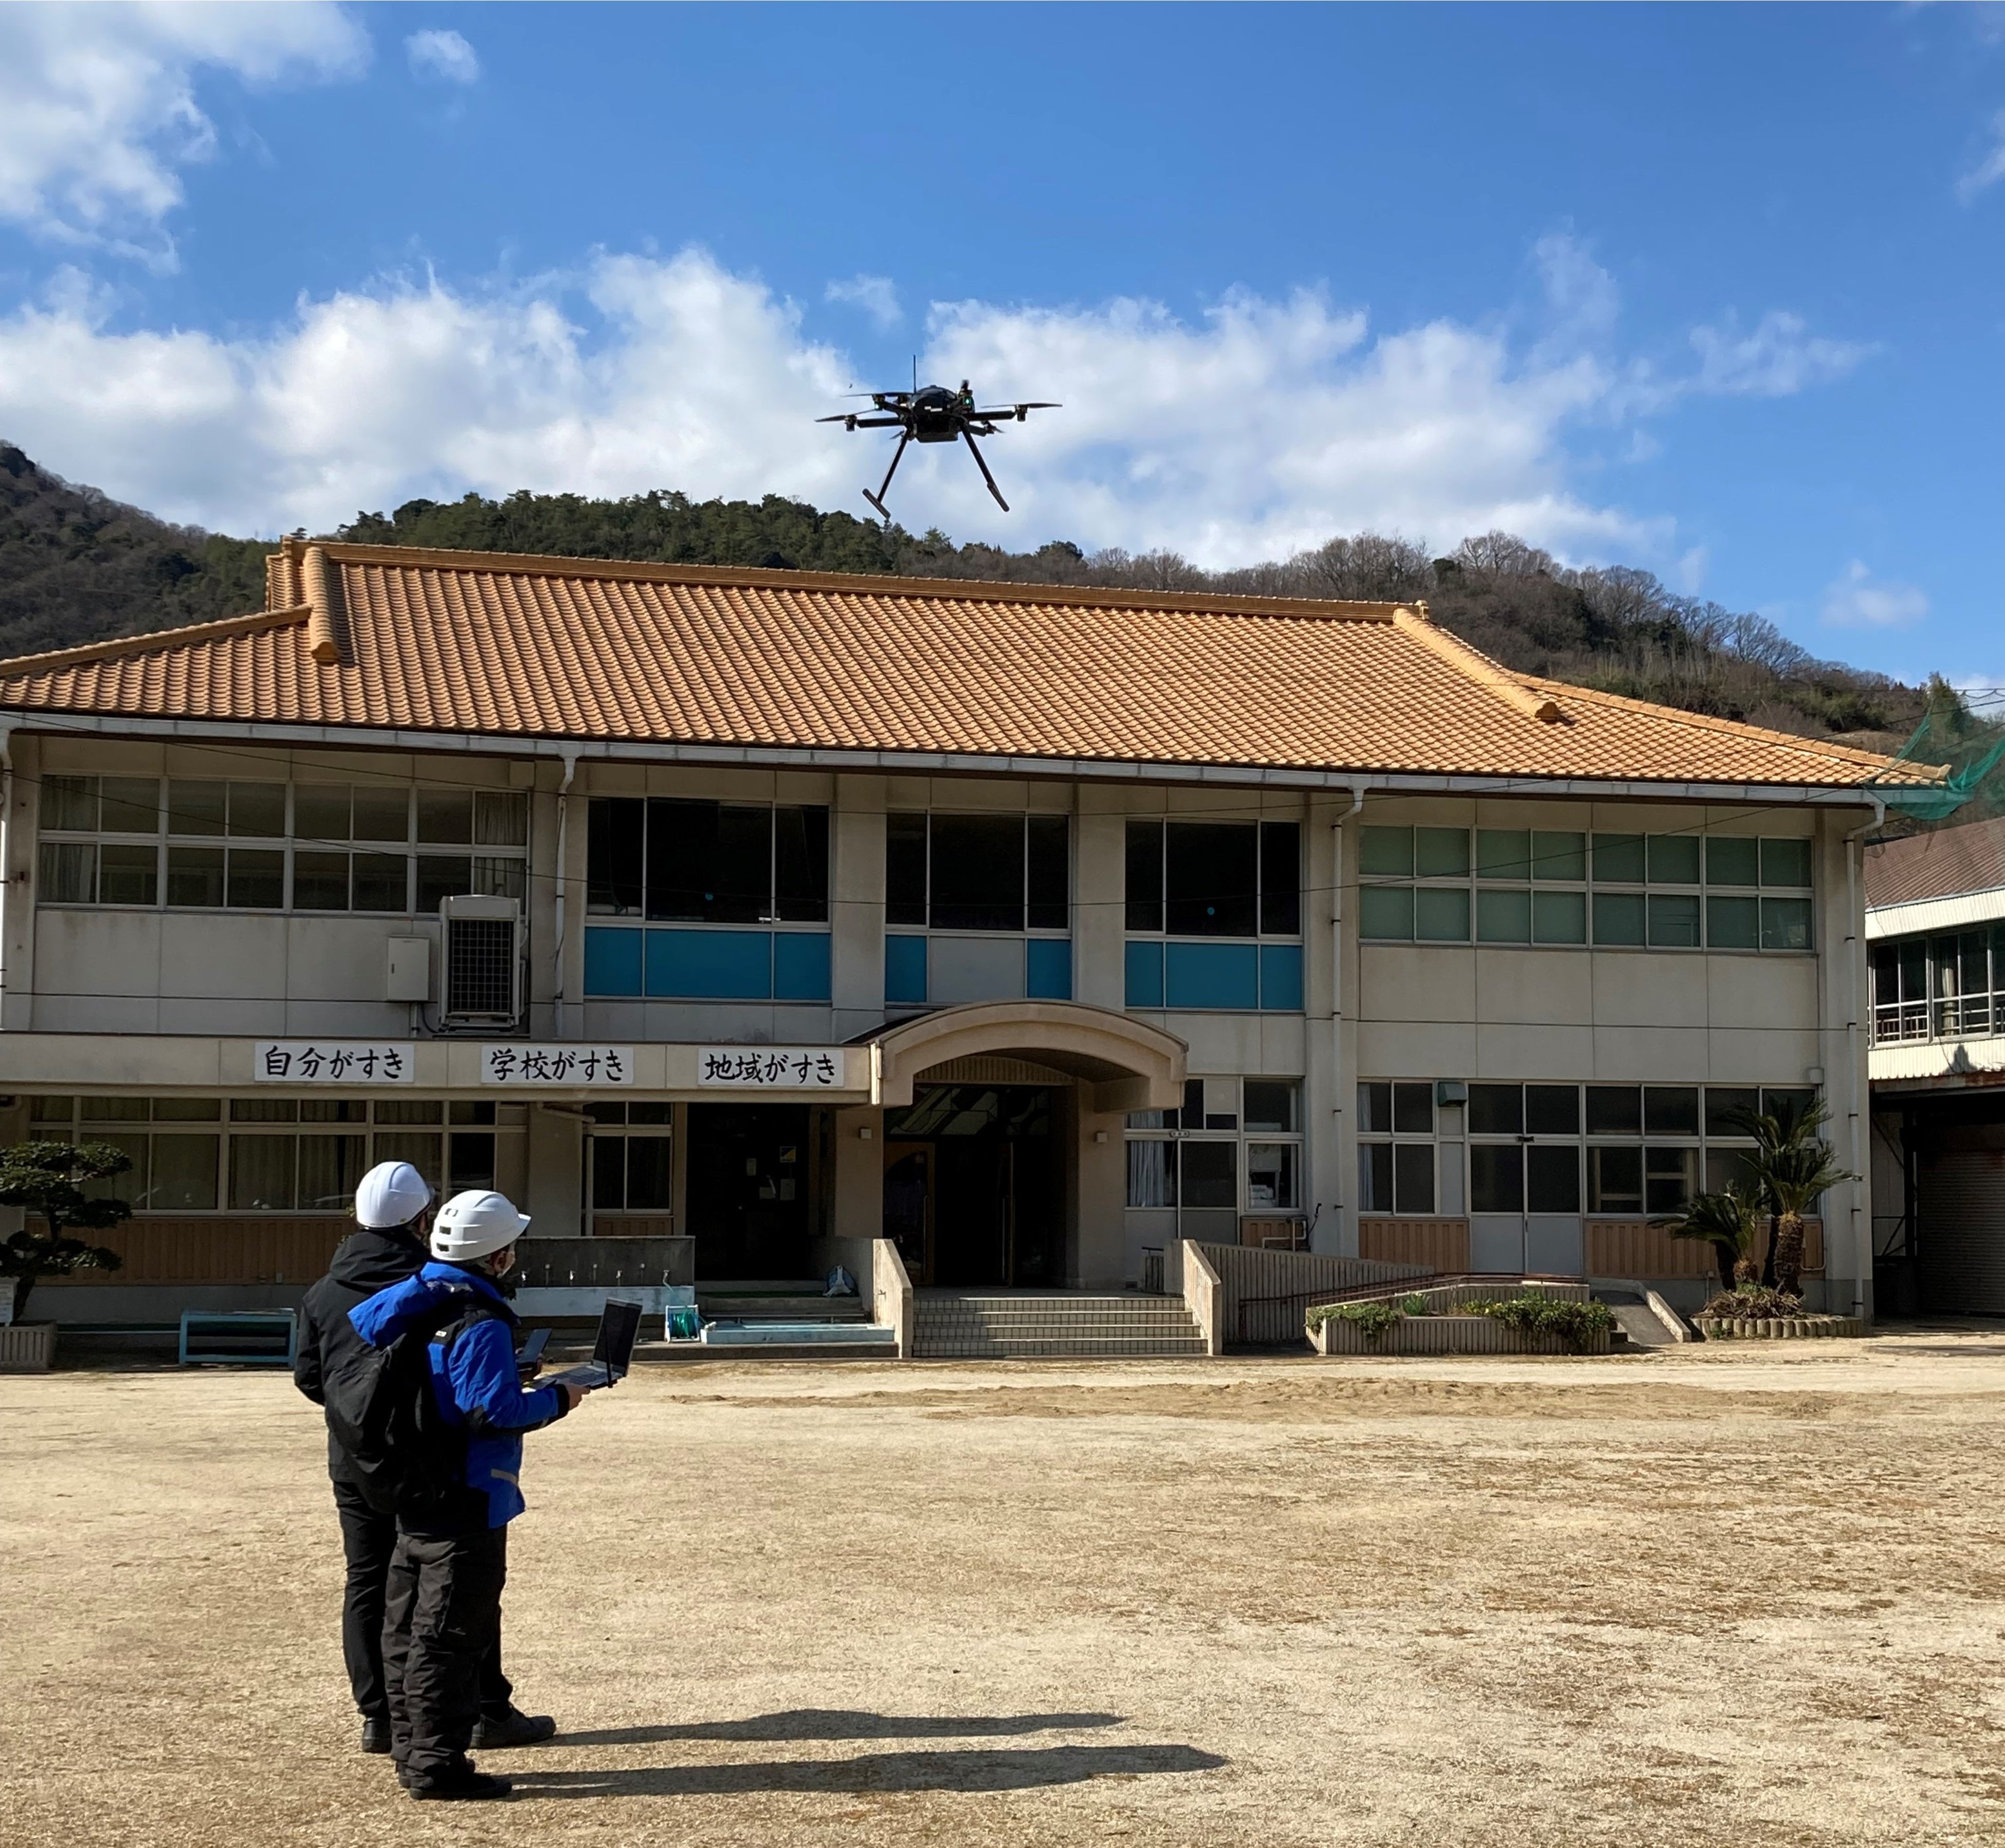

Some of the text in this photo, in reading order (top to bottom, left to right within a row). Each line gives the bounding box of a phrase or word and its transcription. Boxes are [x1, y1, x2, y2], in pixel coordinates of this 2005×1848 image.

[265, 1045, 403, 1079] 自分がすき
[490, 1047, 624, 1082] 学校がすき
[704, 1053, 835, 1084] 地域がすき
